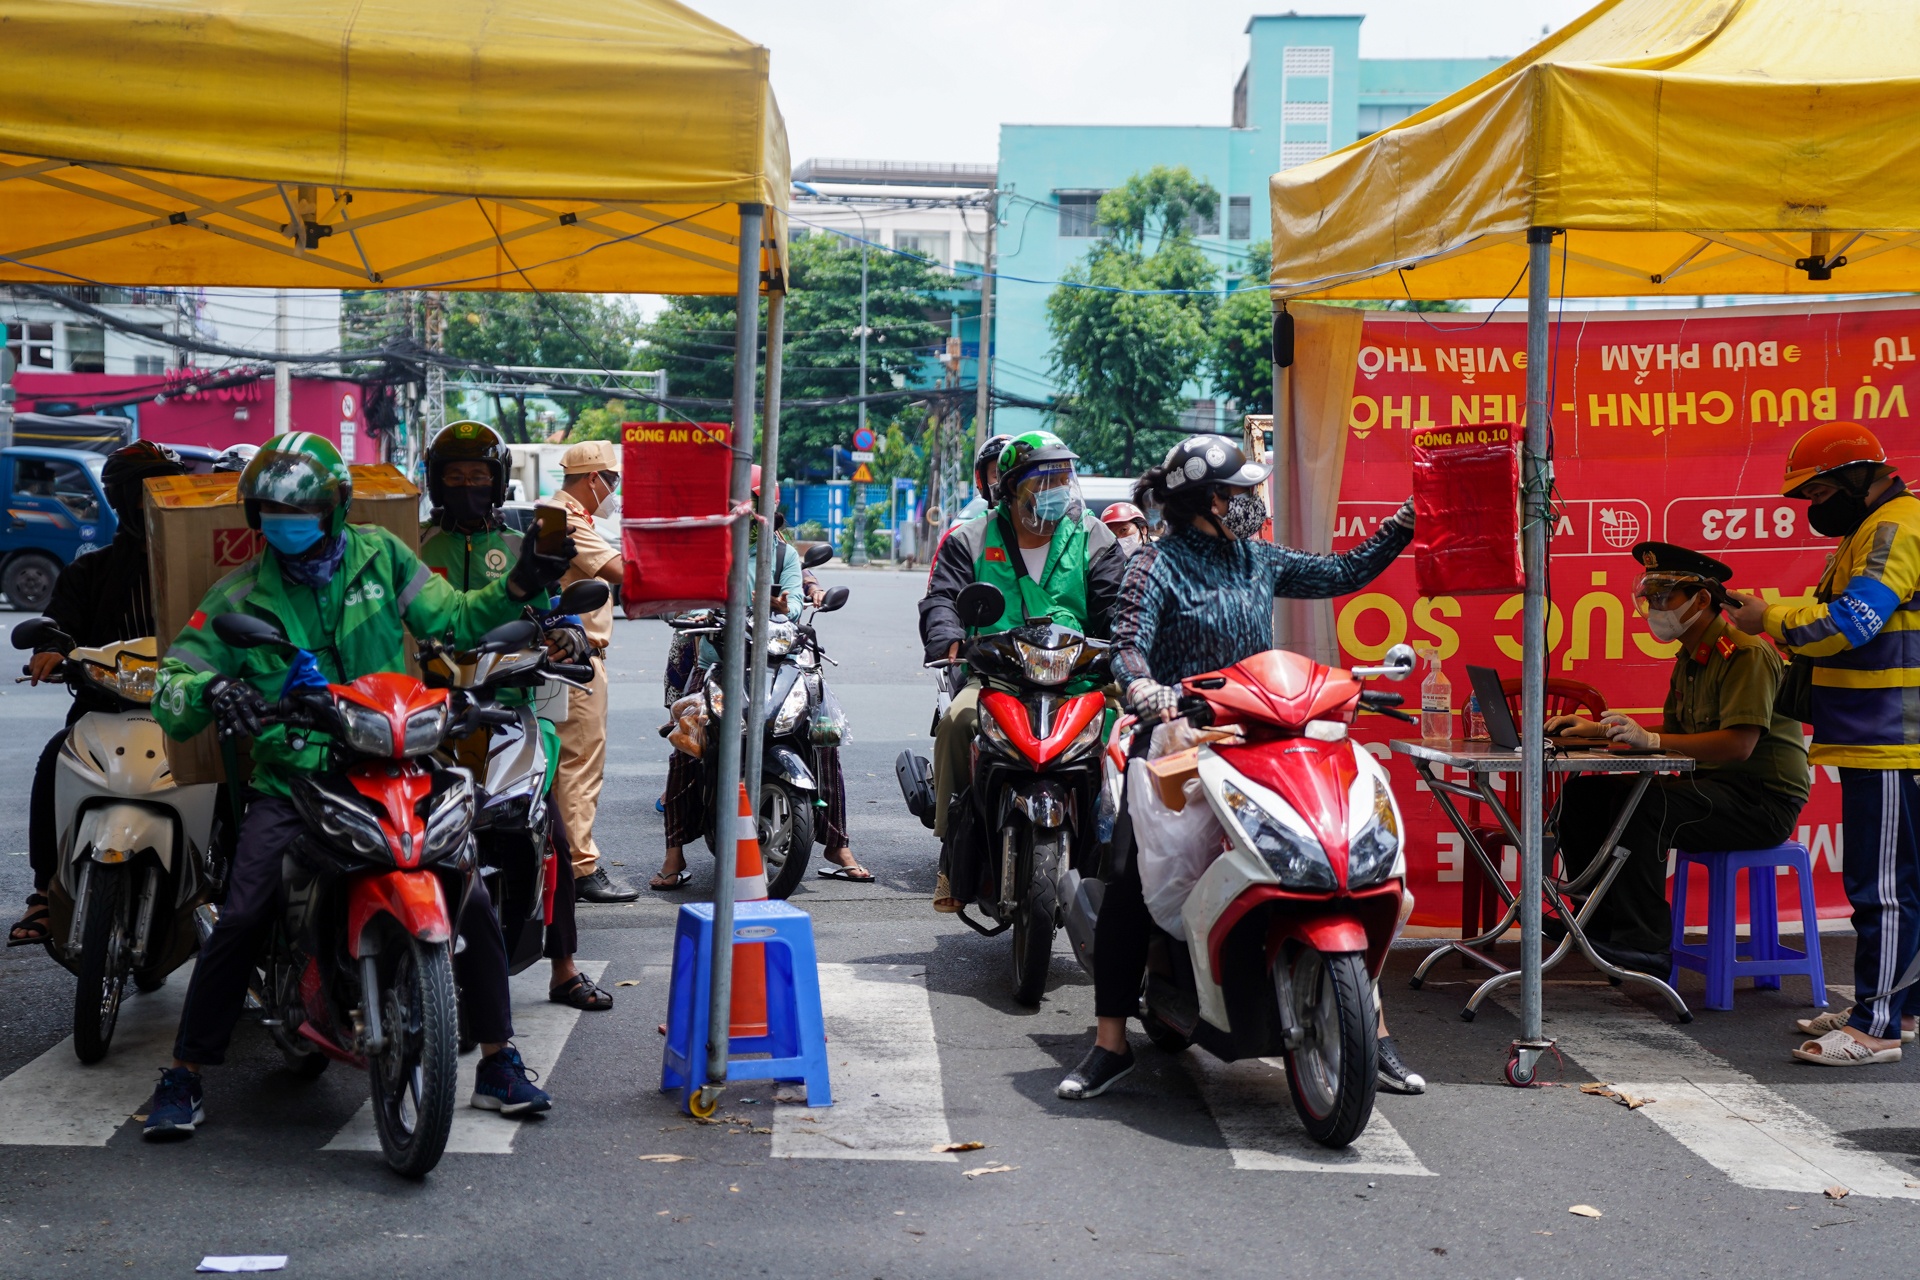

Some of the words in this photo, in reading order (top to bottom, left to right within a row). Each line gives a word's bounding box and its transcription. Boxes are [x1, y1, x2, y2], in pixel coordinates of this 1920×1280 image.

[1357, 346, 1427, 380] THÔ
[1435, 347, 1510, 384] VIỄN
[1601, 342, 1700, 385] PHẨM
[1712, 341, 1779, 372] BƯU
[1588, 390, 1735, 437] CHÍNH
[1750, 387, 1837, 427] BƯU
[1853, 375, 1909, 420] VỤ
[625, 426, 665, 443] CÔNG
[668, 429, 689, 443] AN
[692, 428, 725, 445] Q.10
[1414, 431, 1452, 447] CÔNG
[1456, 432, 1474, 445] AN
[1477, 428, 1509, 444] Q.10
[1701, 506, 1796, 541] 8123
[344, 580, 385, 606] Grab
